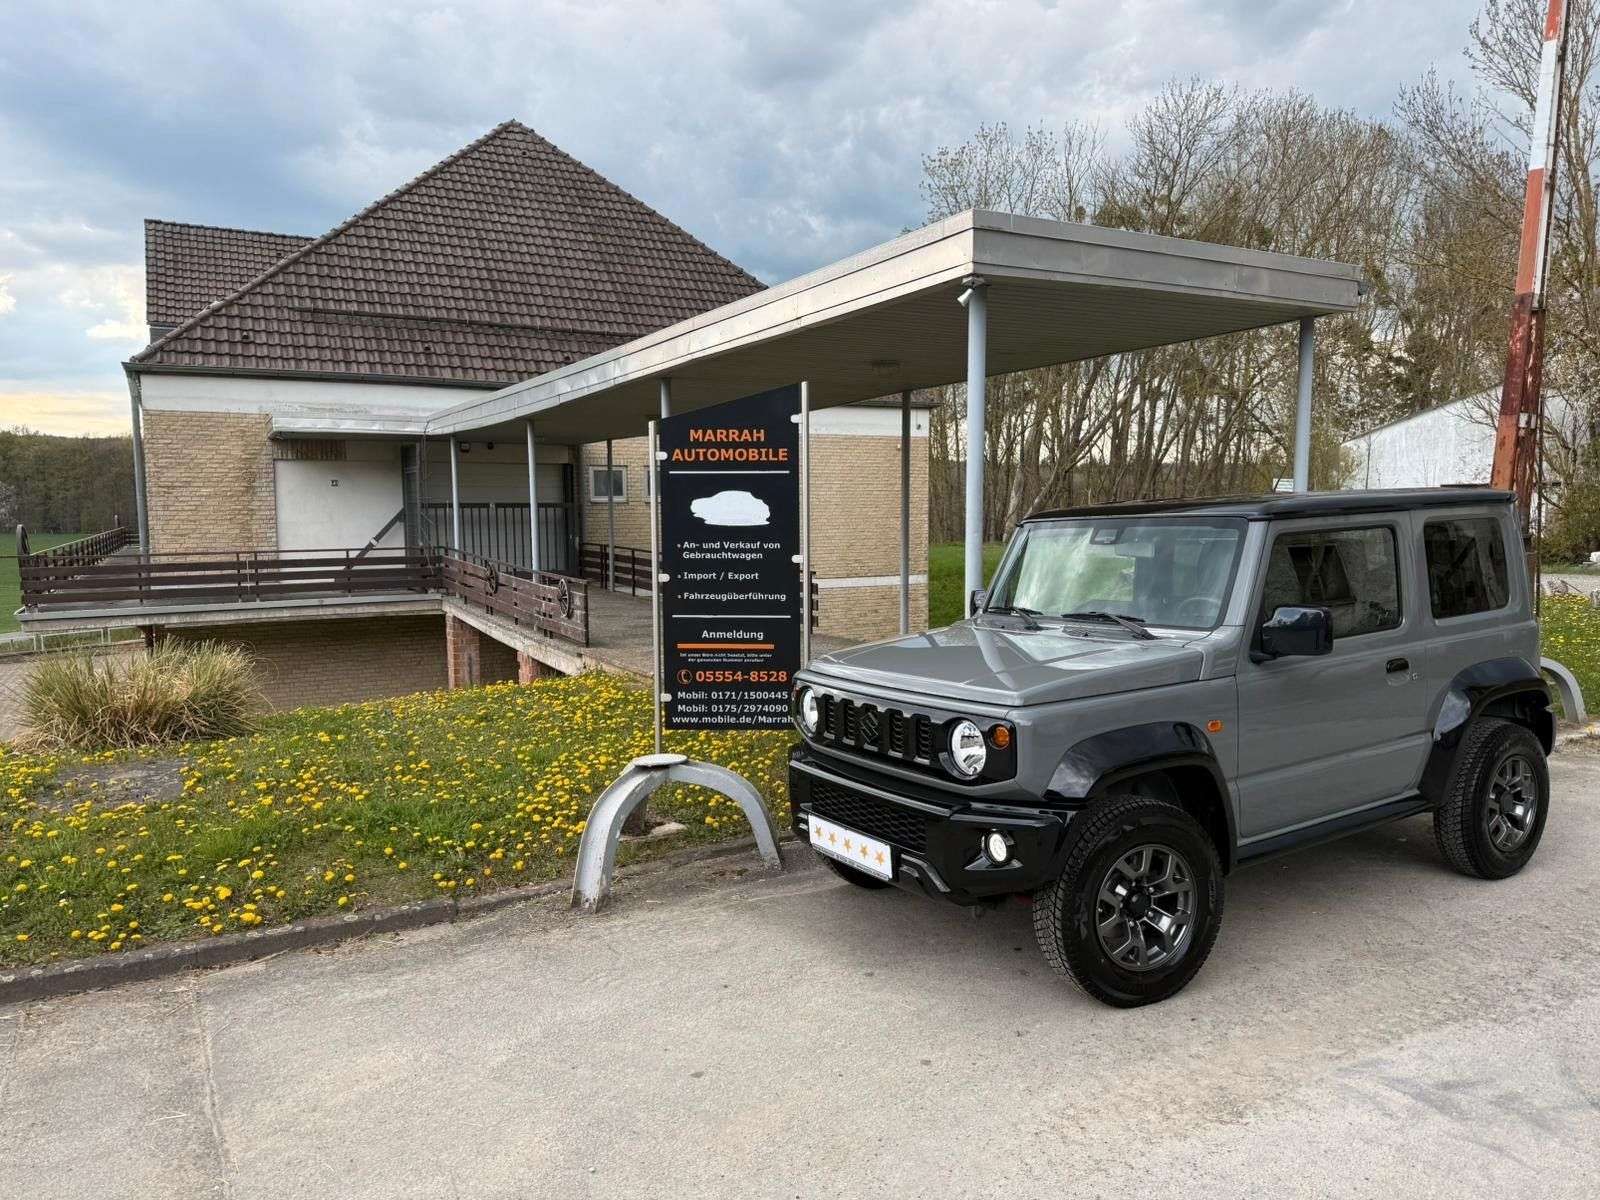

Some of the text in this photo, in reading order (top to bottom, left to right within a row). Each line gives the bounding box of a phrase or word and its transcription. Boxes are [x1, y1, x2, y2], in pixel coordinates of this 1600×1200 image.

[689, 429, 765, 442] MARRAH
[671, 448, 789, 462] AUTOMOBILE
[682, 541, 700, 549] An-
[702, 541, 720, 549] und
[722, 541, 761, 549] Verkauf
[682, 551, 763, 561] Gebrauchtwagen
[683, 571, 760, 581] Import / Export
[683, 592, 787, 602] Fahrzeugüberführung
[701, 630, 764, 641] Anmeldung
[695, 670, 788, 682] 05554-8528
[677, 691, 789, 701] Mobil: 0171/1500445
[677, 704, 789, 714] Mobil: 0175/2974090
[672, 715, 794, 725] www.mobile.de/Marrah
